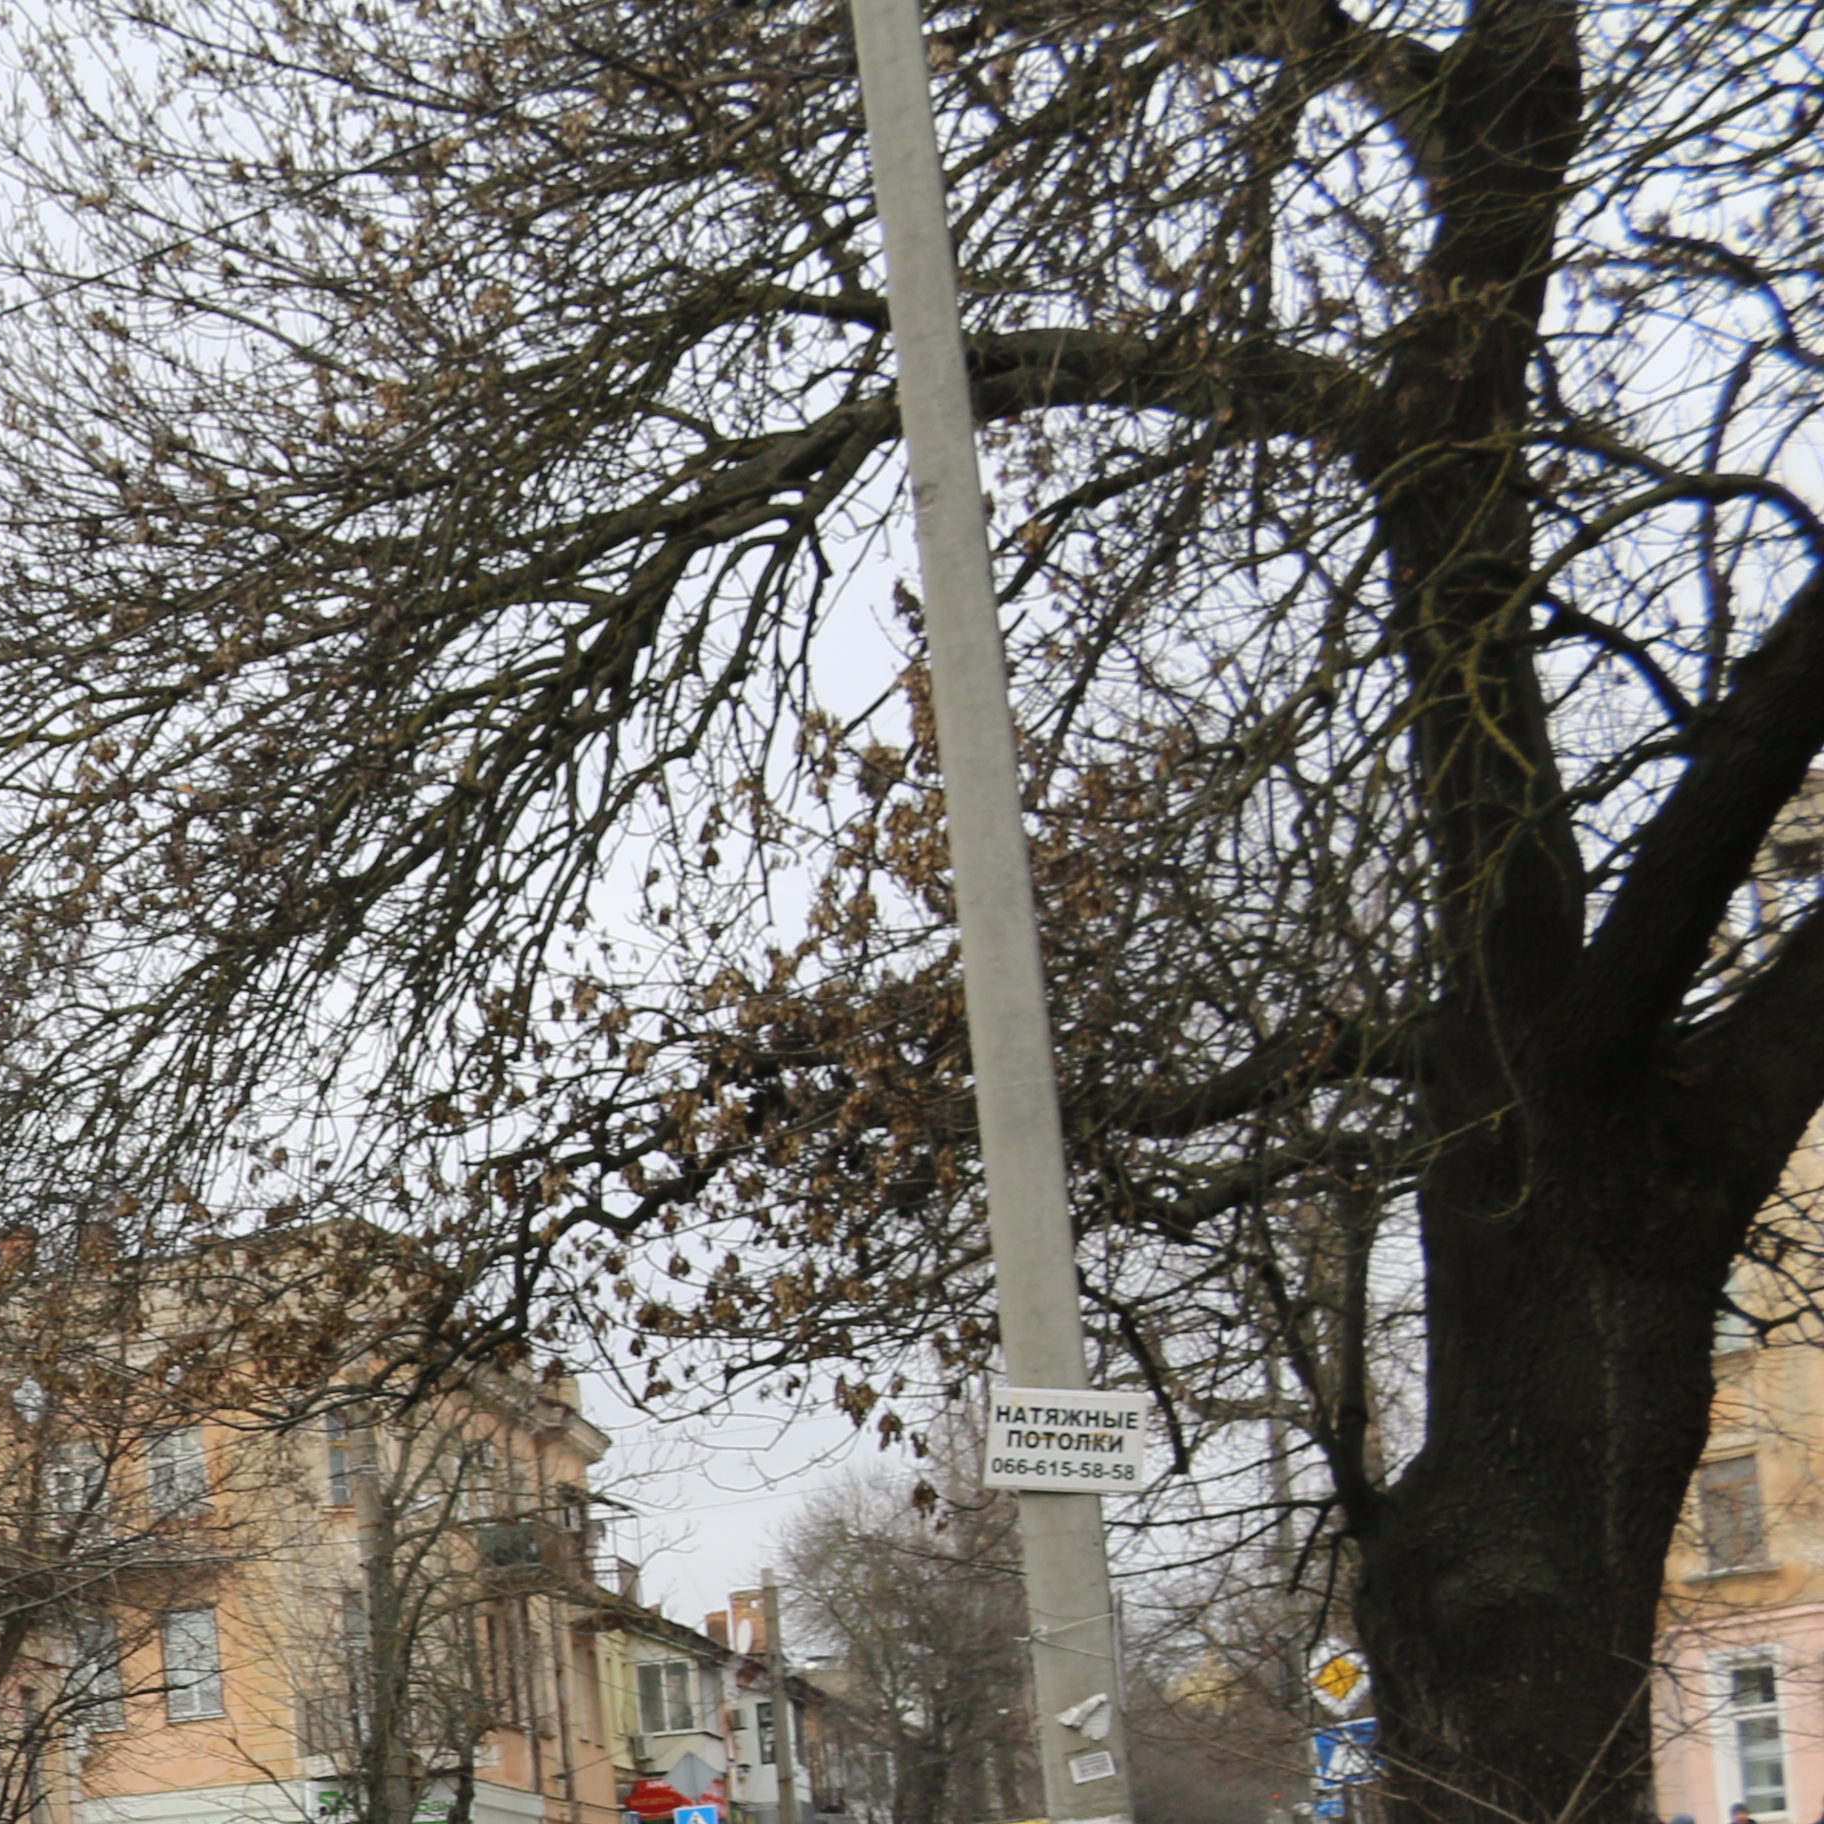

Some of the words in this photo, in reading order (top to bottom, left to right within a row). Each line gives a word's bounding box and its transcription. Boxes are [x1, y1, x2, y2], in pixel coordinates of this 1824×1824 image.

[996, 1405, 1139, 1430] НАТЯЖНЫЕ
[1007, 1430, 1124, 1453] ПОТОЛКИ
[992, 1457, 1135, 1480] 066-615-58-58
